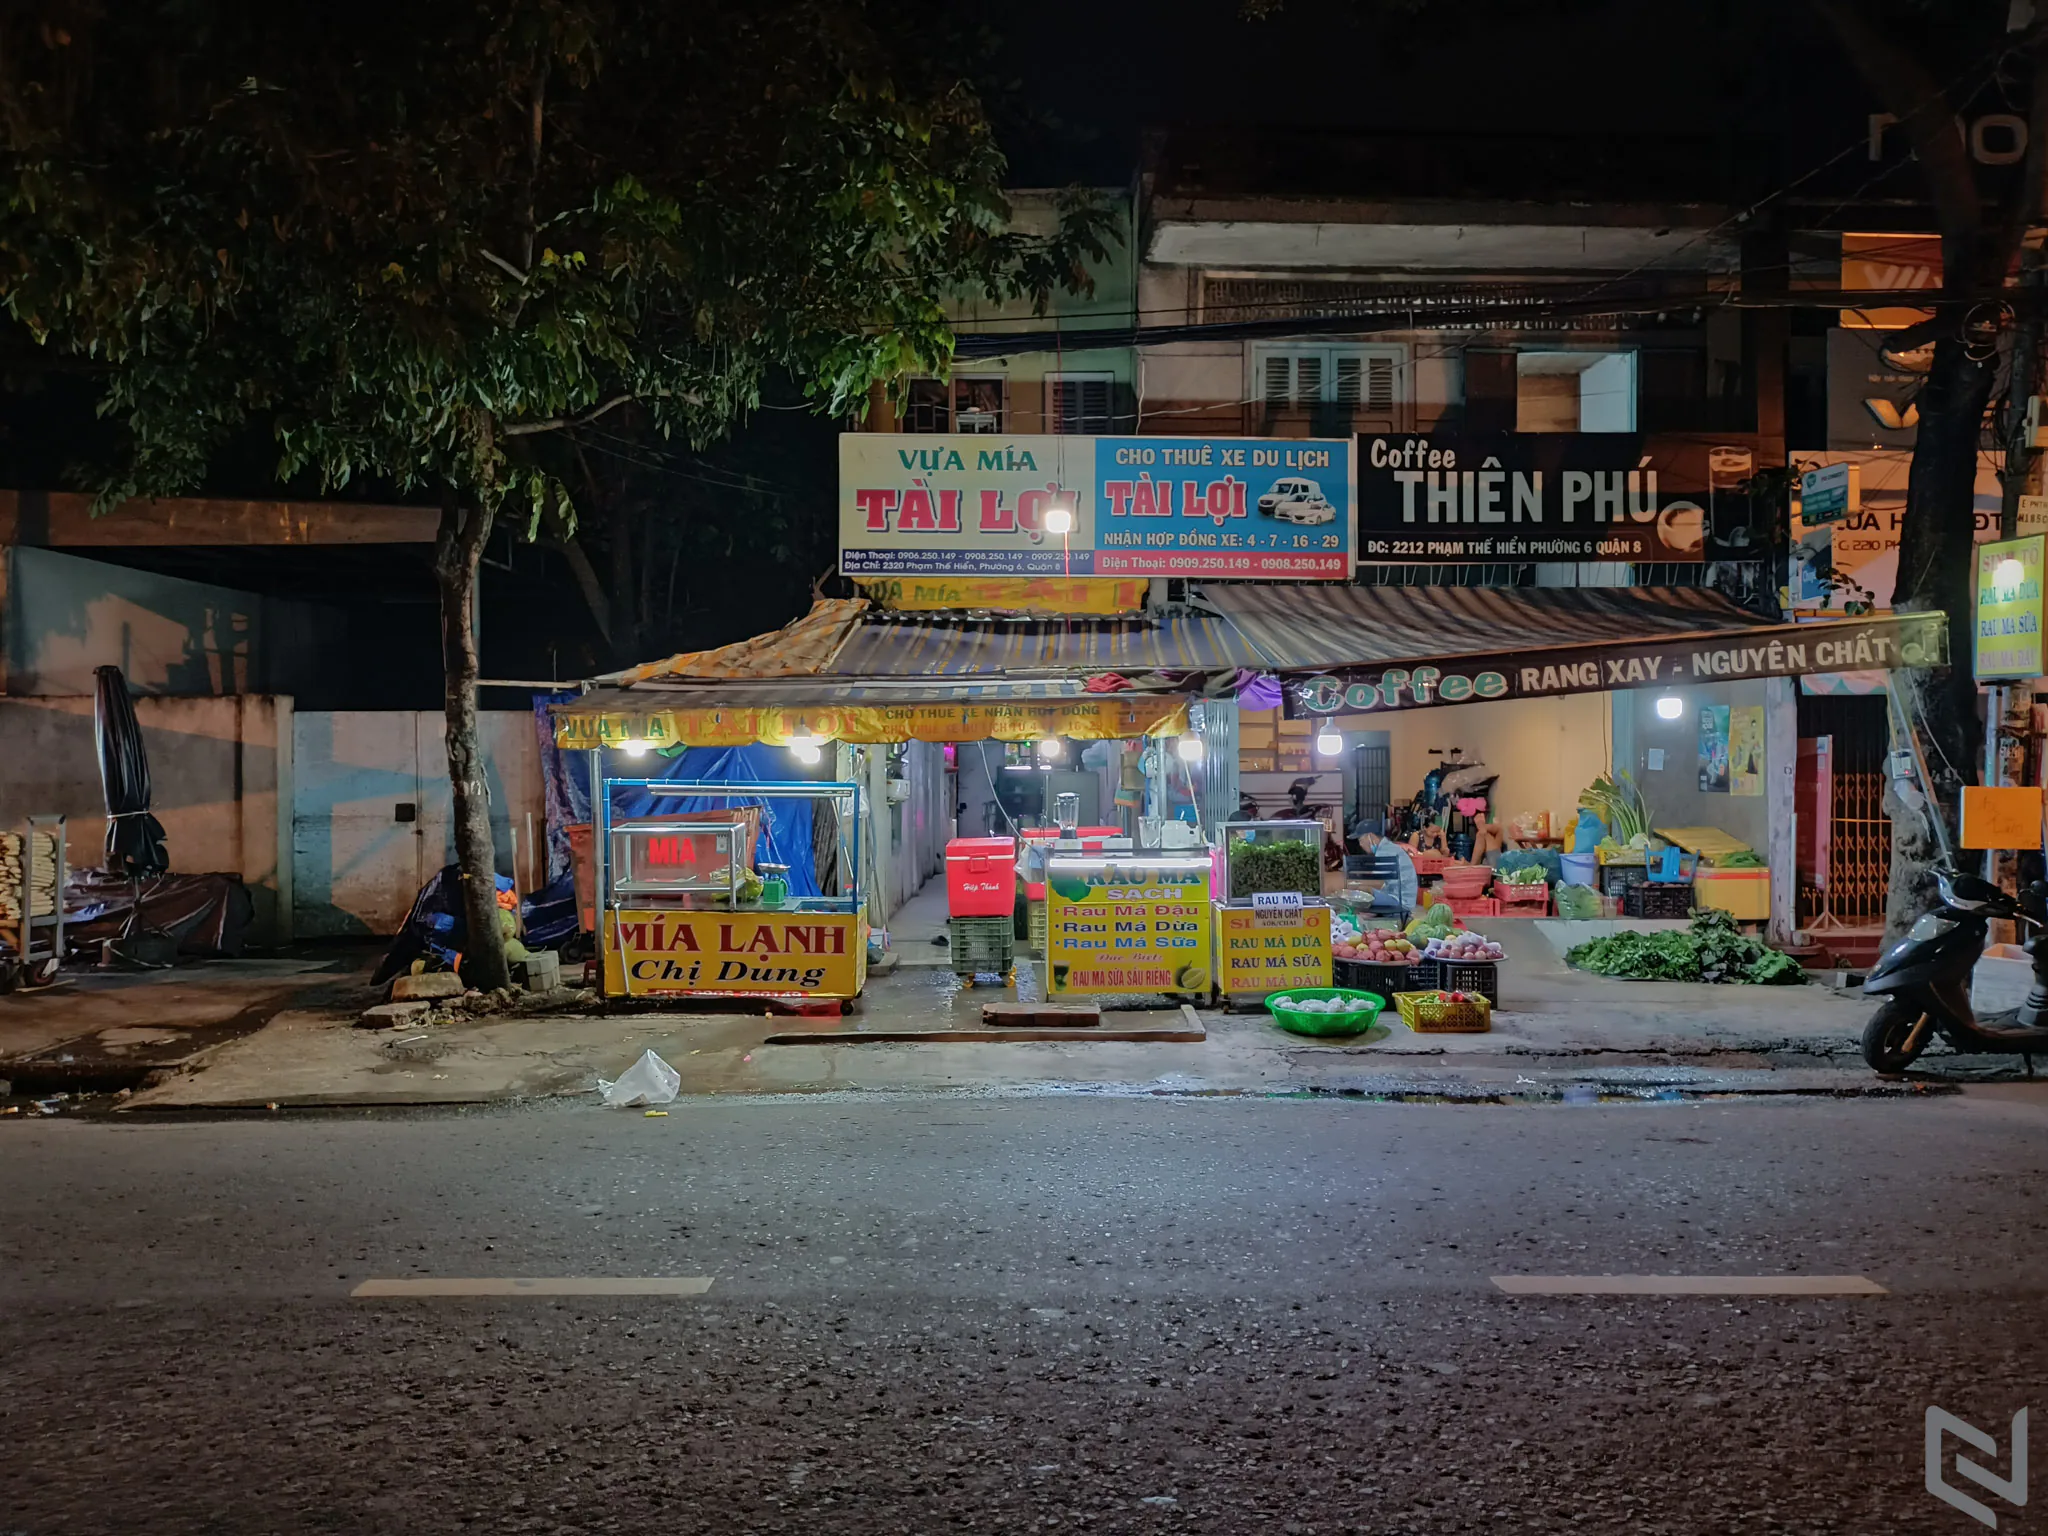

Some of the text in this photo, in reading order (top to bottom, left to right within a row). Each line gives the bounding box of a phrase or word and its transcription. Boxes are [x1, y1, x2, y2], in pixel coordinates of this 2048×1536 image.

[898, 445, 1039, 477] VỰA MÍA
[1115, 445, 1329, 470] CHO THUÊ XE DU LỊCH
[1370, 438, 1456, 469] Coffee
[1393, 455, 1658, 523] THIÊN PHÚ
[856, 478, 962, 533] TÀI
[1104, 472, 1248, 527] TÀI LỢI
[1104, 530, 1141, 546] NHẬN
[1146, 531, 1174, 547] HỢP
[1179, 528, 1217, 547] ĐỒNG
[1220, 533, 1242, 547] XE:
[1247, 534, 1256, 547] 4
[1269, 535, 1278, 547] 7
[1292, 535, 1309, 548] 16
[1321, 535, 1339, 548] 29
[1367, 535, 1642, 557] ĐC: 2212 PHẠM THẾ HIỂN PHƯỜNG 6 QUẬN 8
[845, 551, 867, 560] Điện
[868, 551, 896, 561] Thoại:
[1102, 556, 1128, 571] Điện
[1131, 556, 1166, 571] Thoại:
[1169, 557, 1250, 571] 0909.250.149
[1261, 557, 1341, 571] 0908.250.149
[845, 561, 863, 571] Địa
[883, 561, 905, 570] 2320
[1304, 665, 1509, 713] Coffee
[1520, 661, 1599, 692] RANG
[1607, 655, 1663, 684] XAY
[1692, 640, 1806, 677] NGUYÊN
[1815, 629, 1891, 665] CHẤT
[1257, 892, 1299, 905] RAU MÁ
[1063, 904, 1199, 918] Rau Má Đậu
[1255, 906, 1283, 920] NGUYÊN
[1063, 920, 1199, 933] Rau Má Dừa
[612, 914, 847, 962] MÍA LẠNH
[1063, 936, 1198, 949] Rau Má Sữa
[1230, 937, 1259, 949] RAU
[1264, 934, 1287, 948] MÁ
[1231, 953, 1322, 969] RAU MÁ SỮA
[631, 959, 826, 987] Chị Dung
[1072, 970, 1089, 987] RAU
[1231, 977, 1260, 988] RAU
[1265, 974, 1288, 988] MÁ
